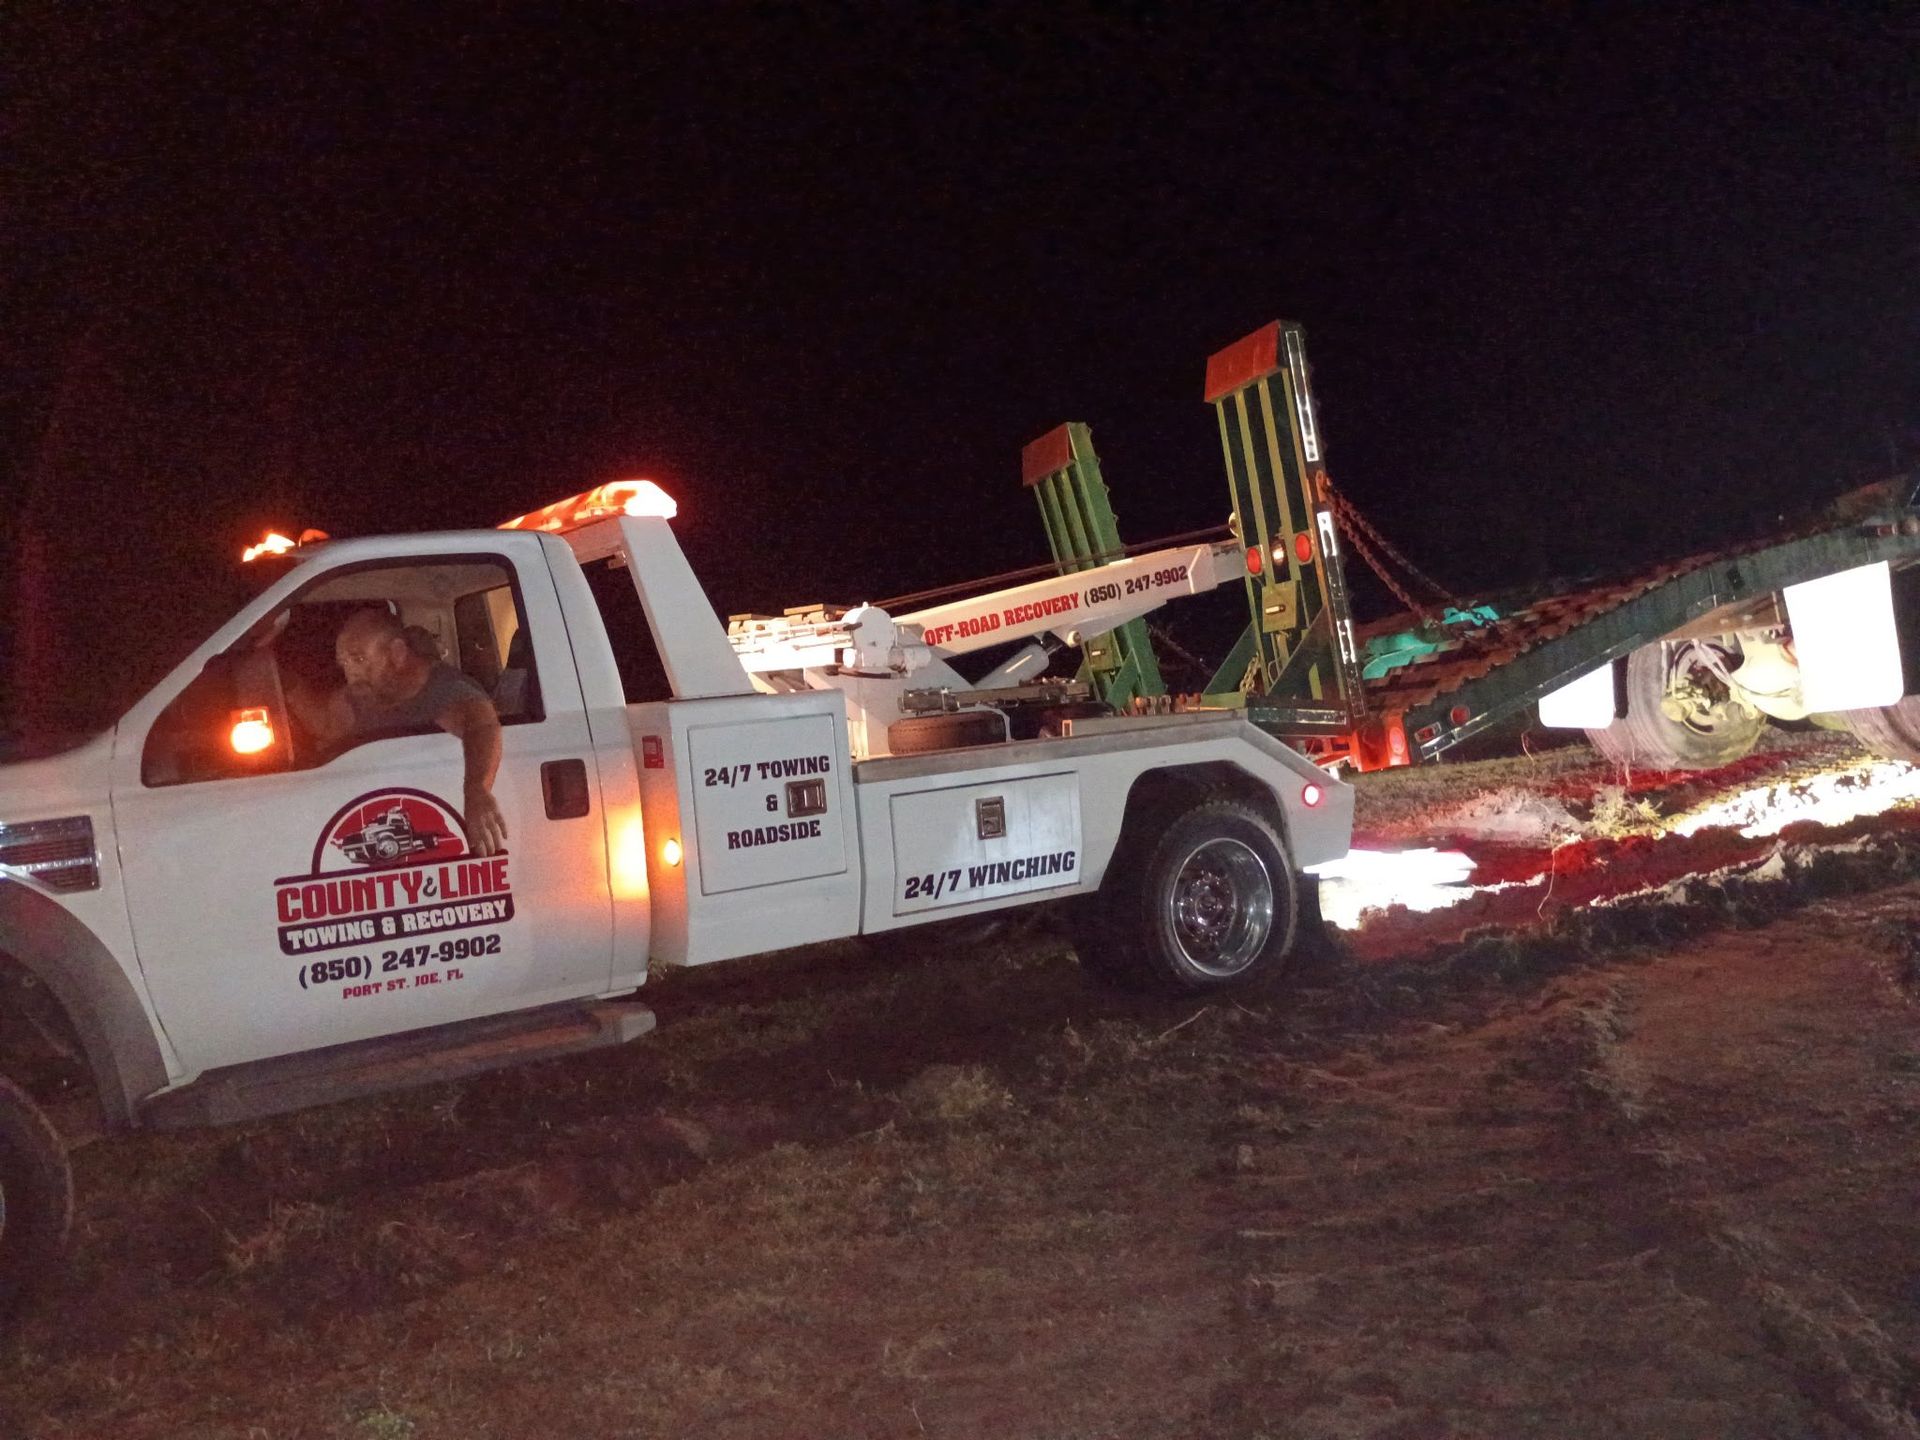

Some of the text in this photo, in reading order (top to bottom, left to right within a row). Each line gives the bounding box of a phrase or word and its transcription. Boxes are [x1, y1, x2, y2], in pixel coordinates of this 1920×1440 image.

[924, 565, 1189, 647] OFF-ROAD RECOVERY (850) 247-9902
[704, 755, 831, 787] 24/7 TOWING
[765, 795, 779, 812] &
[727, 820, 821, 850] ROADSIDE
[276, 858, 512, 923] COUNTY LINE
[904, 851, 1076, 901] 24/7 WINCHING
[286, 899, 507, 950] TOWING & RECOVERY
[298, 934, 502, 990] (850) 247-9902
[342, 982, 383, 1000] PORT
[386, 978, 411, 992] ST.
[446, 968, 464, 982] FL
